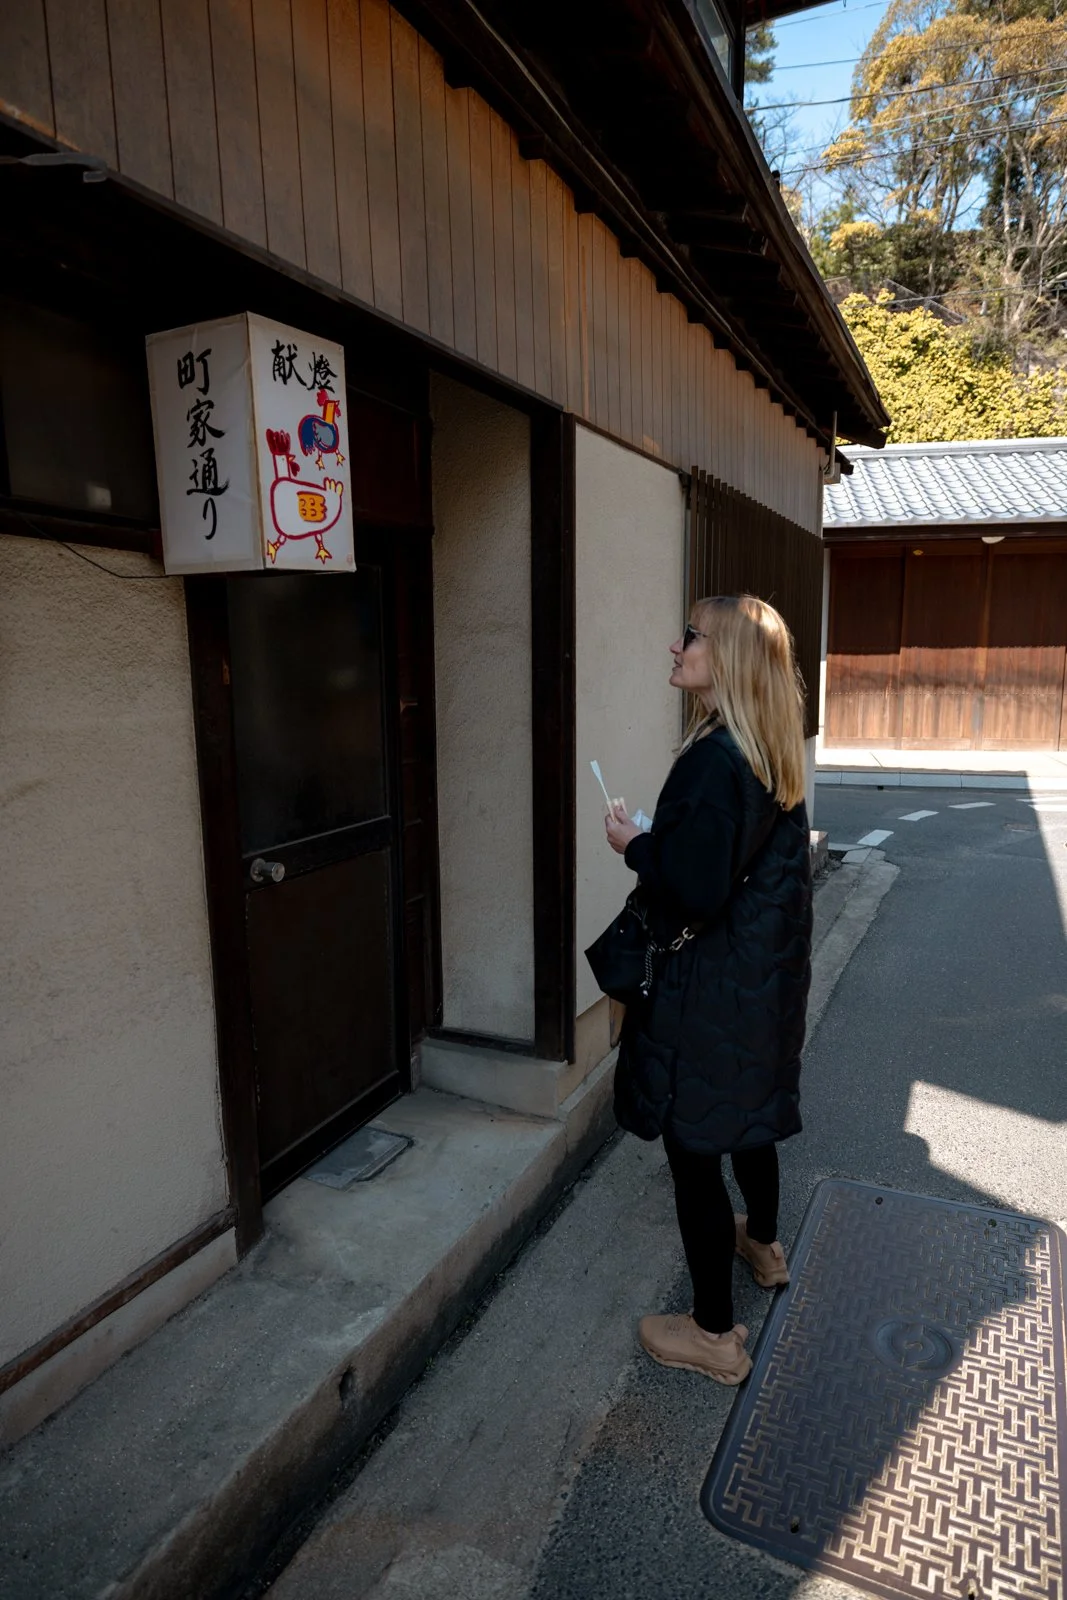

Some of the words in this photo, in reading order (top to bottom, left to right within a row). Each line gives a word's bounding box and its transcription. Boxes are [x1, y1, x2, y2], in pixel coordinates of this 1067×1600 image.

[271, 339, 338, 394] 献燈
[177, 348, 230, 540] 町家通り
